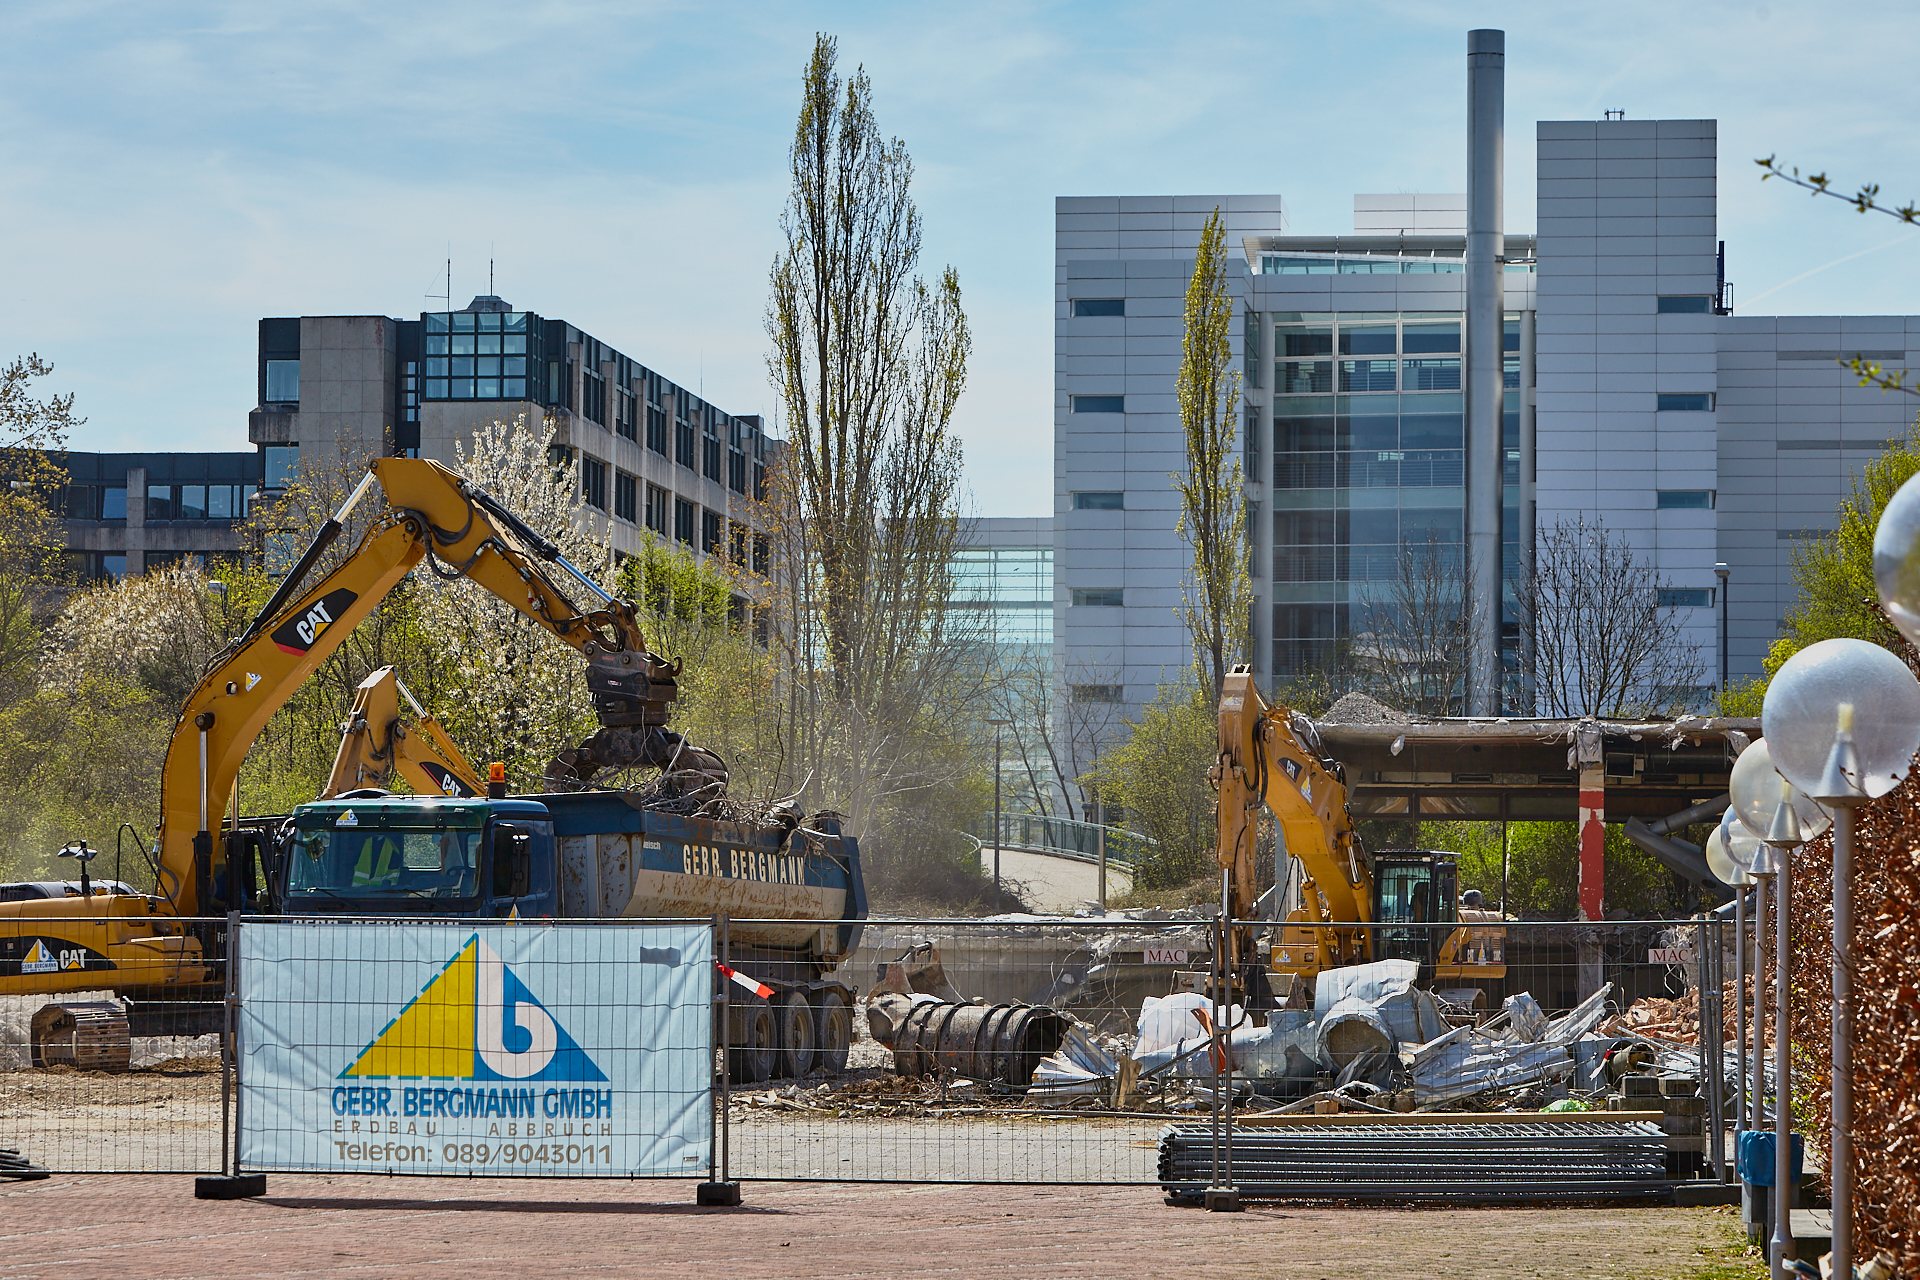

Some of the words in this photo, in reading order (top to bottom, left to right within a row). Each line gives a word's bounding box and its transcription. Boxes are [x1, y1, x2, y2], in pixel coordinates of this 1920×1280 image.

[296, 600, 333, 645] CAT
[1286, 760, 1296, 780] CAT
[442, 773, 462, 797] CAT
[683, 844, 723, 877] GEBR.
[730, 849, 805, 885] BERGMANN
[60, 948, 87, 970] CAT
[1148, 949, 1185, 963] MAC
[1652, 949, 1689, 963] MAC
[332, 1086, 398, 1117] GEBR.
[403, 1087, 535, 1119] BERGMANN
[543, 1088, 612, 1119] GMBH
[334, 1120, 436, 1135] ERDBAU
[488, 1123, 611, 1137] ABBRUCH
[334, 1141, 433, 1162] Telefon:
[443, 1143, 610, 1166] 089/9043011
